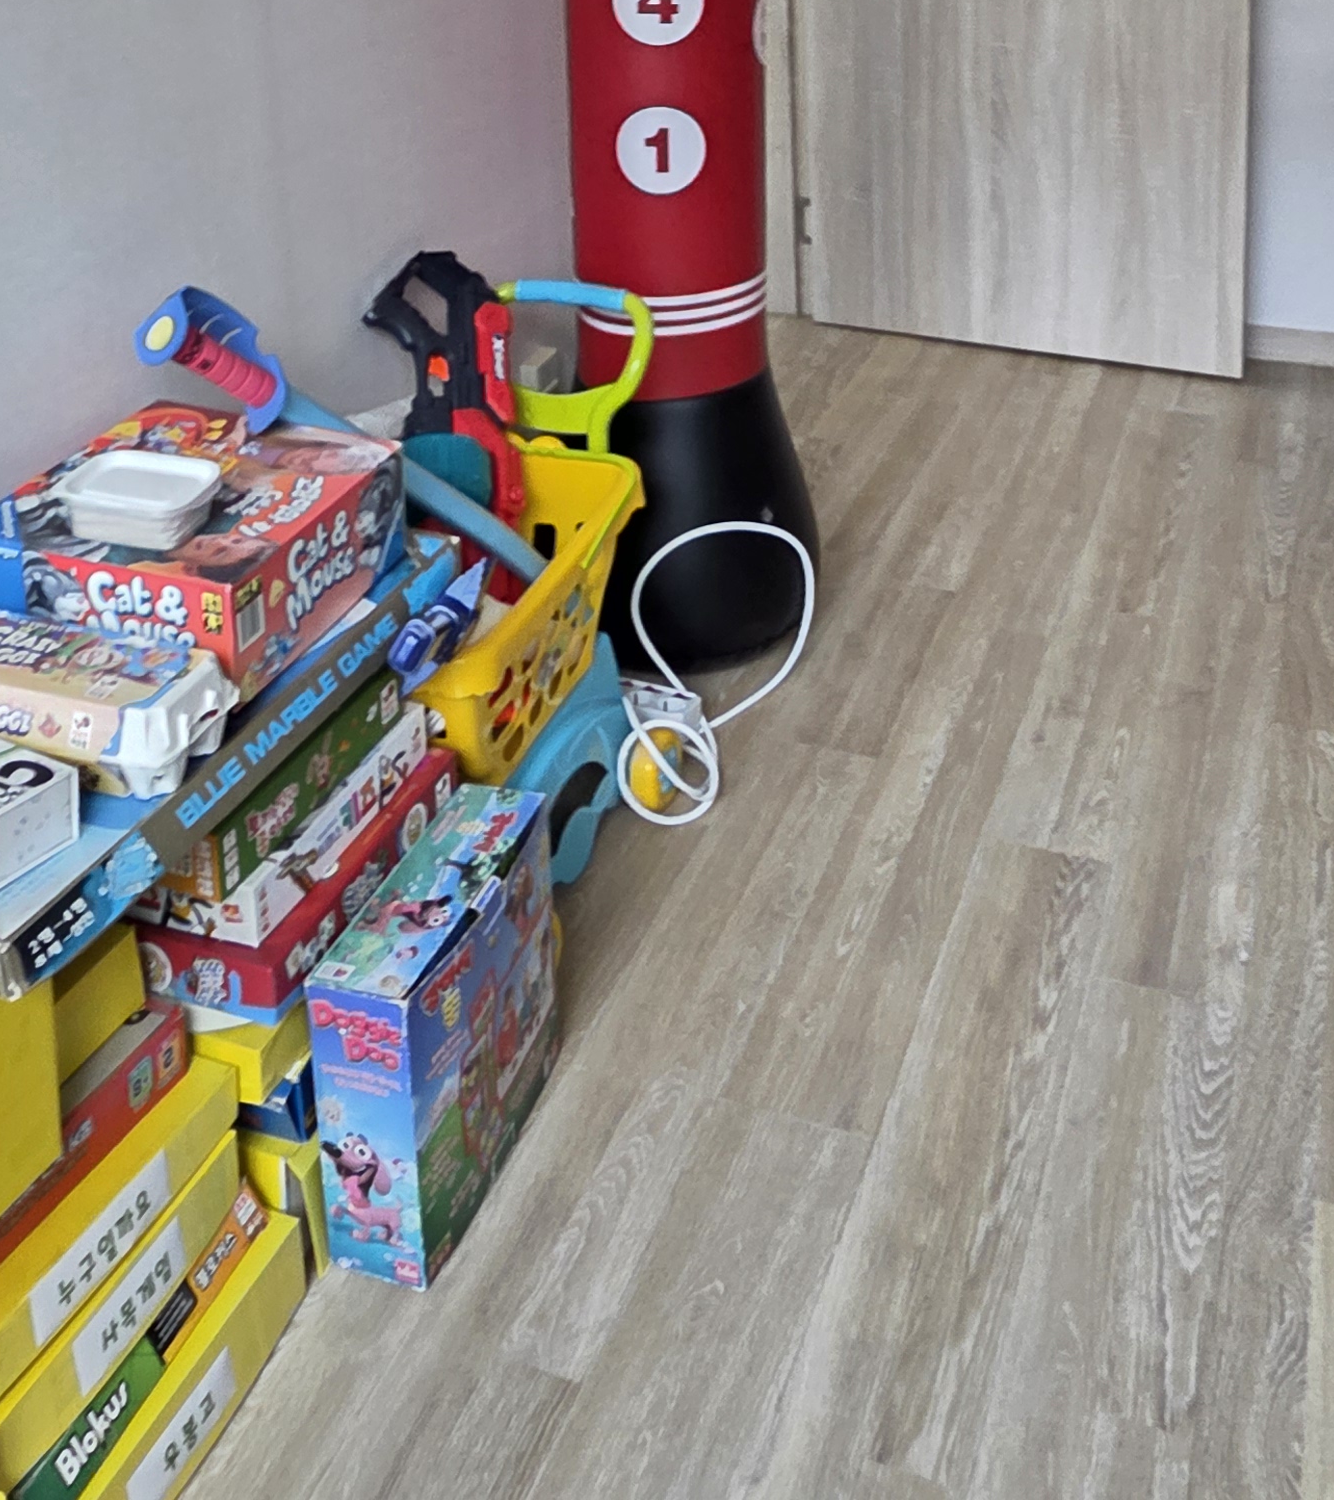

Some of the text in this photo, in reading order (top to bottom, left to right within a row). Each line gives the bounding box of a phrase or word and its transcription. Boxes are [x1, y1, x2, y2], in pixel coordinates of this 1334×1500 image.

[644, 128, 669, 173] 1
[287, 510, 350, 584] Cat &
[87, 570, 153, 617] Cat
[155, 585, 189, 627] &
[175, 762, 247, 830] BLUE
[243, 668, 339, 765] MARBLE
[337, 614, 399, 678] GAME
[54, 1381, 128, 1487] Blokus
